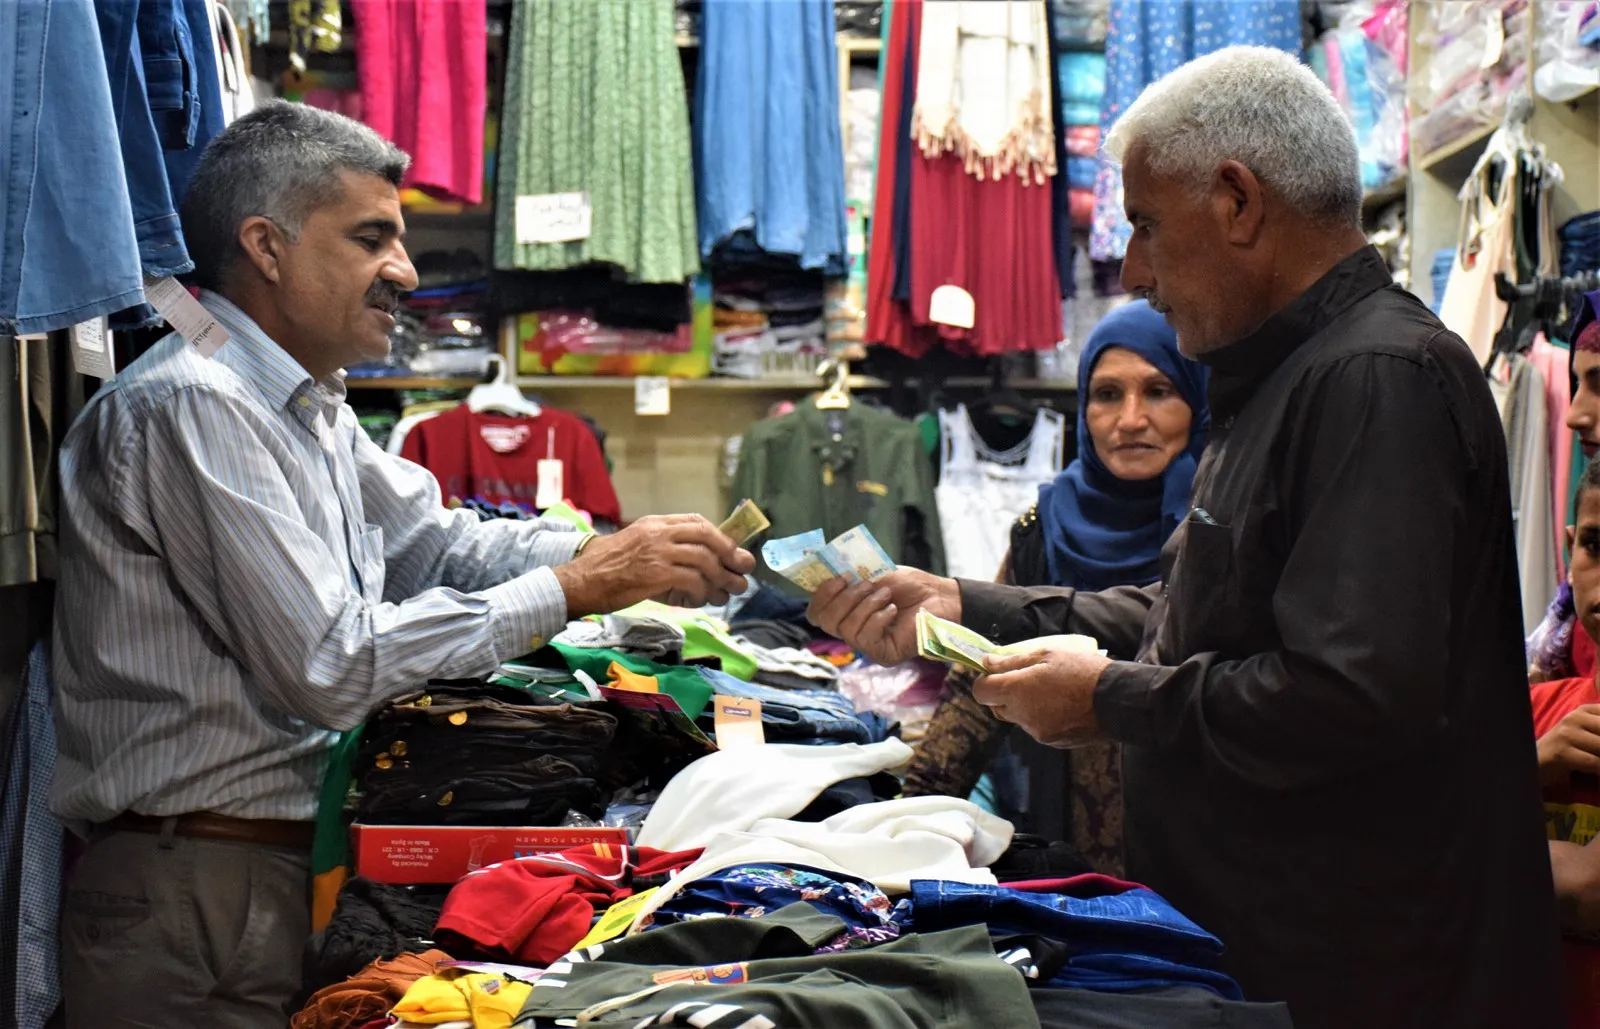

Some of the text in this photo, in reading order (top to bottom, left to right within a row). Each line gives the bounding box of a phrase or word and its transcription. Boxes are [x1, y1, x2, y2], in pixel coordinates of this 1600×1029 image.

[515, 836, 608, 844] SOCKS FOR MEN
